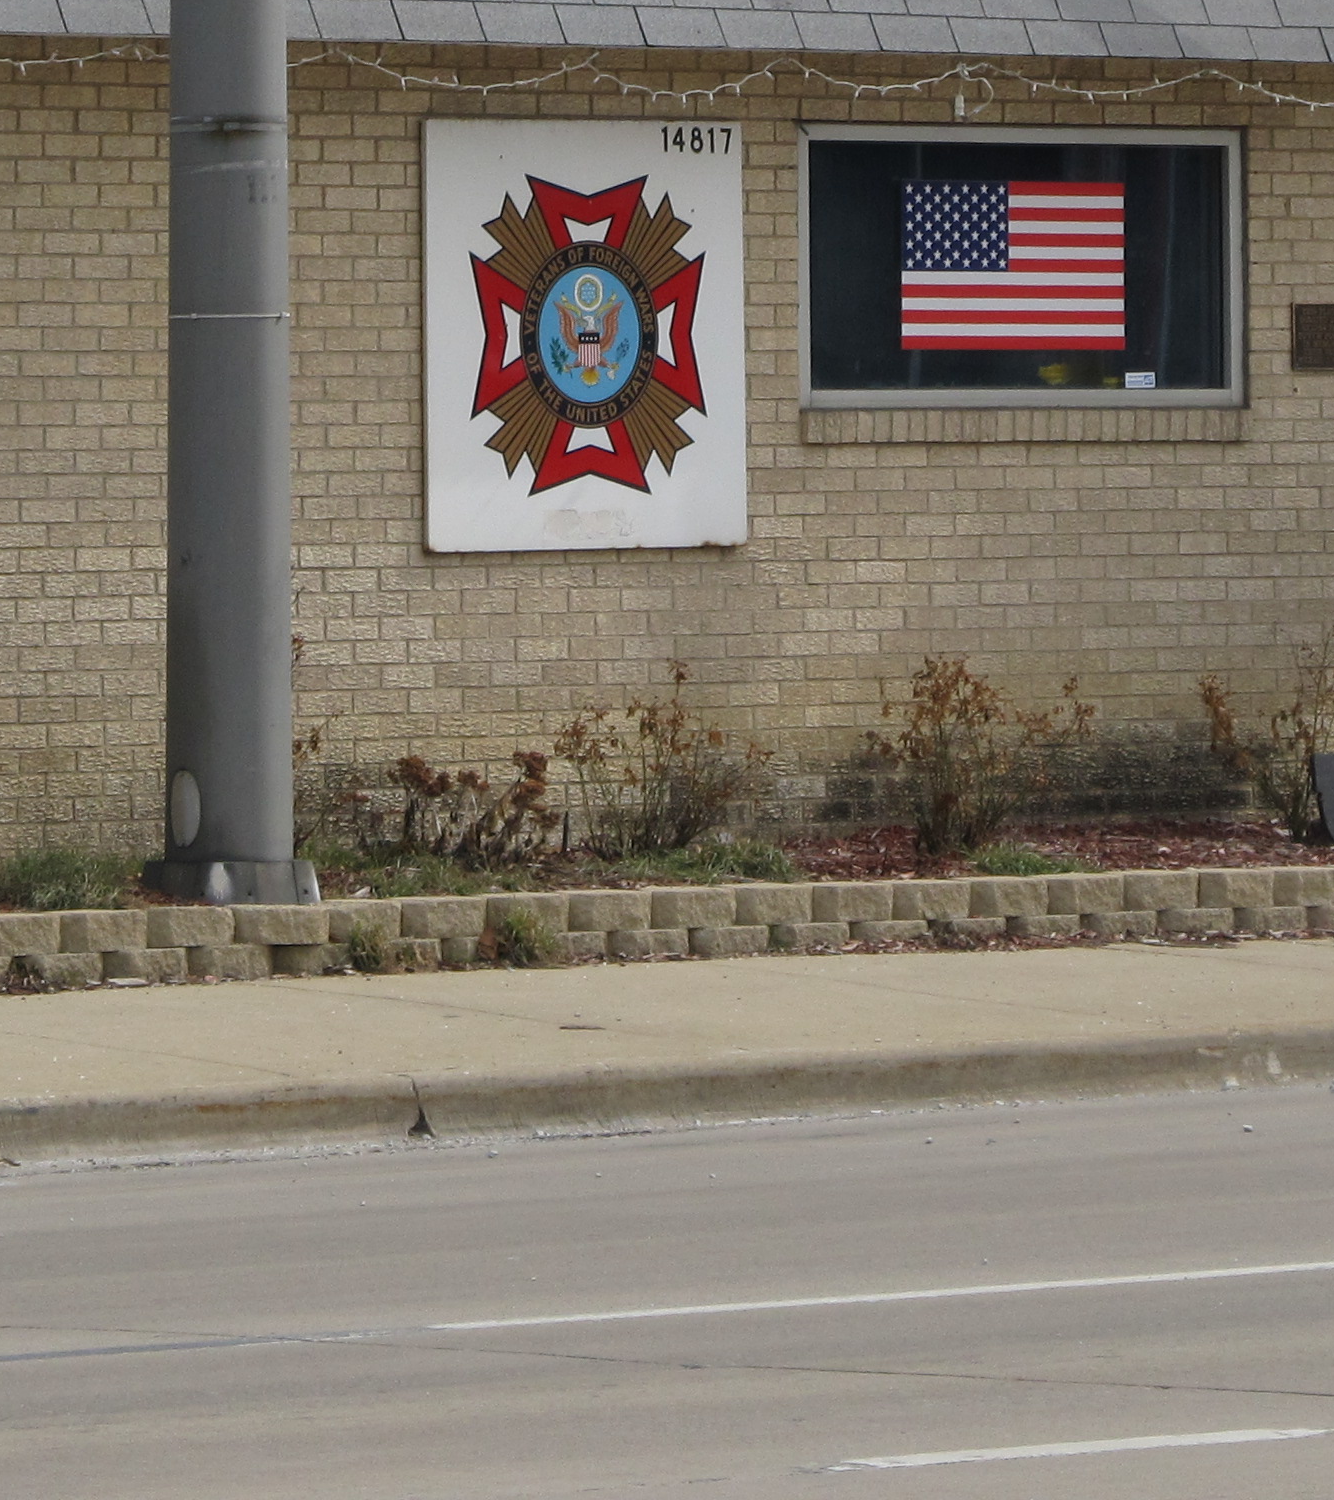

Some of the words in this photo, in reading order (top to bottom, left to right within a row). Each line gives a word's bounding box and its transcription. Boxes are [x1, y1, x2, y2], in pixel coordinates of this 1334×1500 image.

[661, 126, 732, 155] 14817
[524, 256, 565, 334] VETERANS
[569, 247, 585, 264] OF
[589, 247, 640, 288] FOREIGN
[636, 288, 655, 334] WARS
[528, 353, 542, 374] OF
[538, 379, 560, 411] THE
[567, 403, 617, 422] UNITED
[623, 351, 653, 405] STATES
